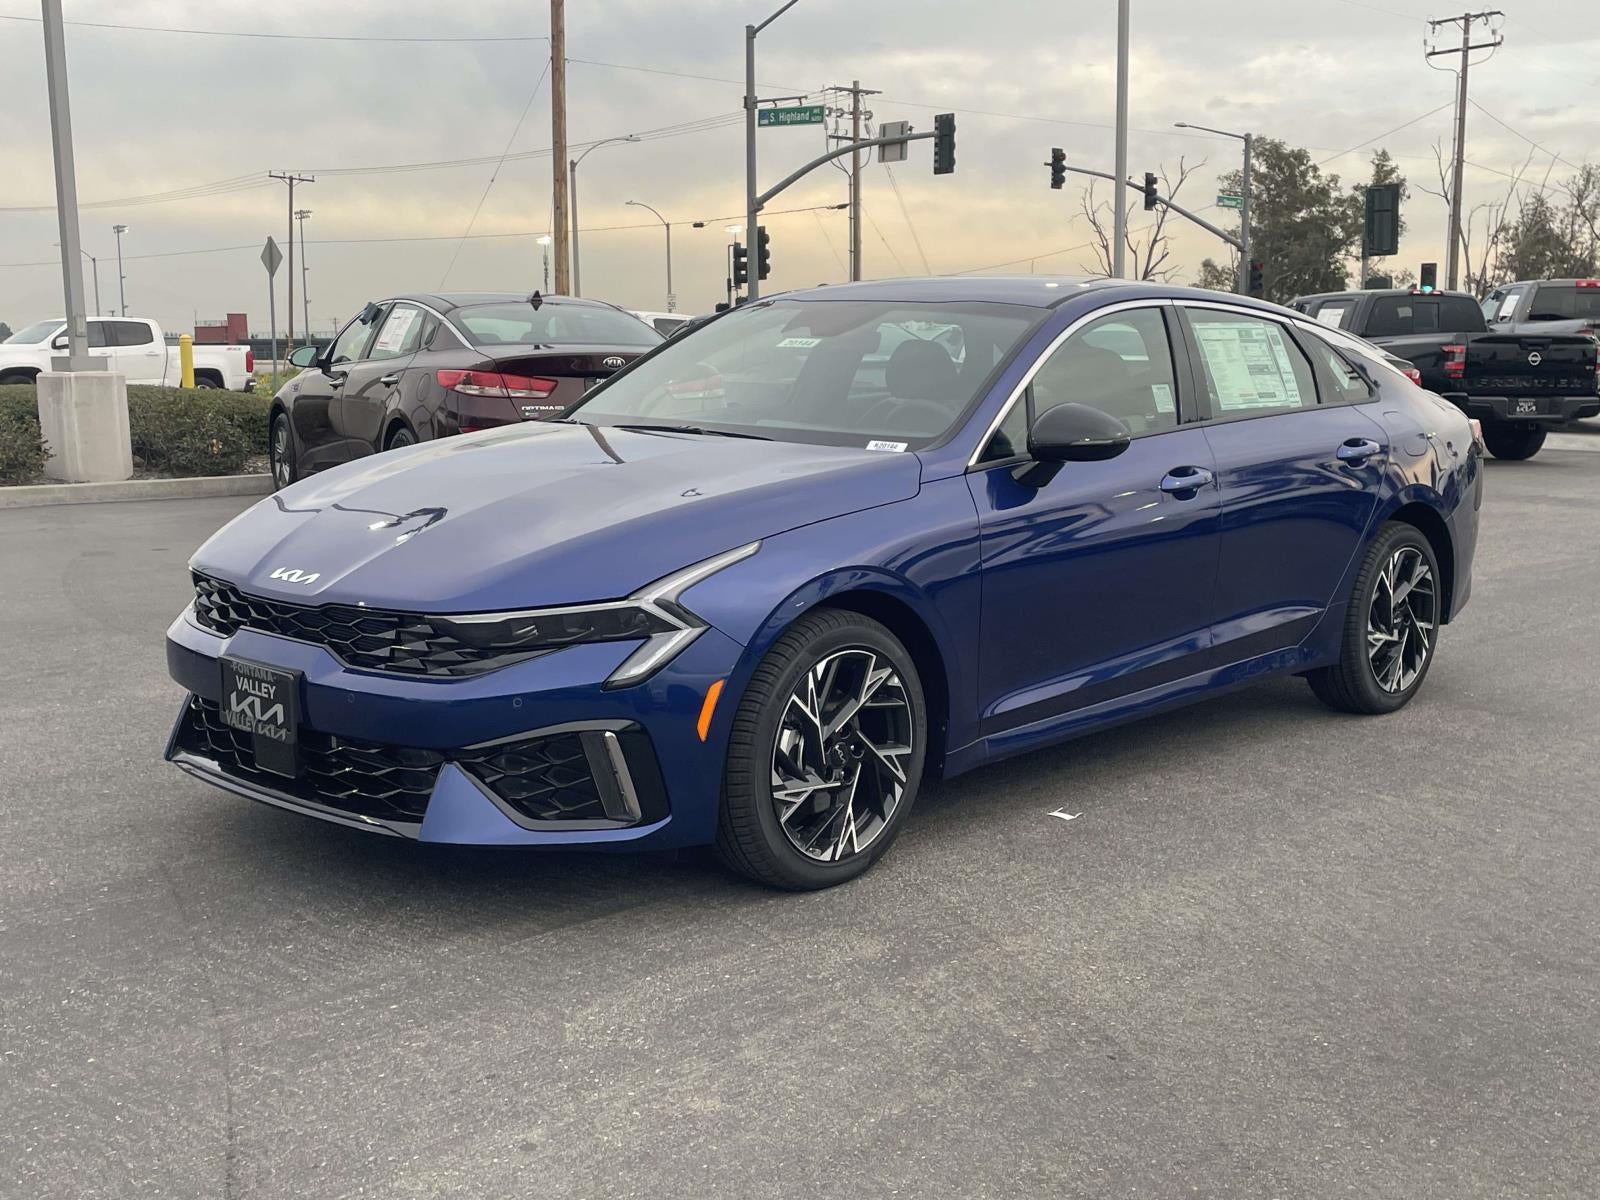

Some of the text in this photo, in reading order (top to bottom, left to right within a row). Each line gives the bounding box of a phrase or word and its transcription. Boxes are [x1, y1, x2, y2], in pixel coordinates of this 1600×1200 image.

[779, 111, 809, 123] Highland
[269, 566, 321, 585] KIA
[235, 675, 276, 699] VALLEY
[230, 691, 285, 726] KIA
[225, 709, 257, 733] VALLEY
